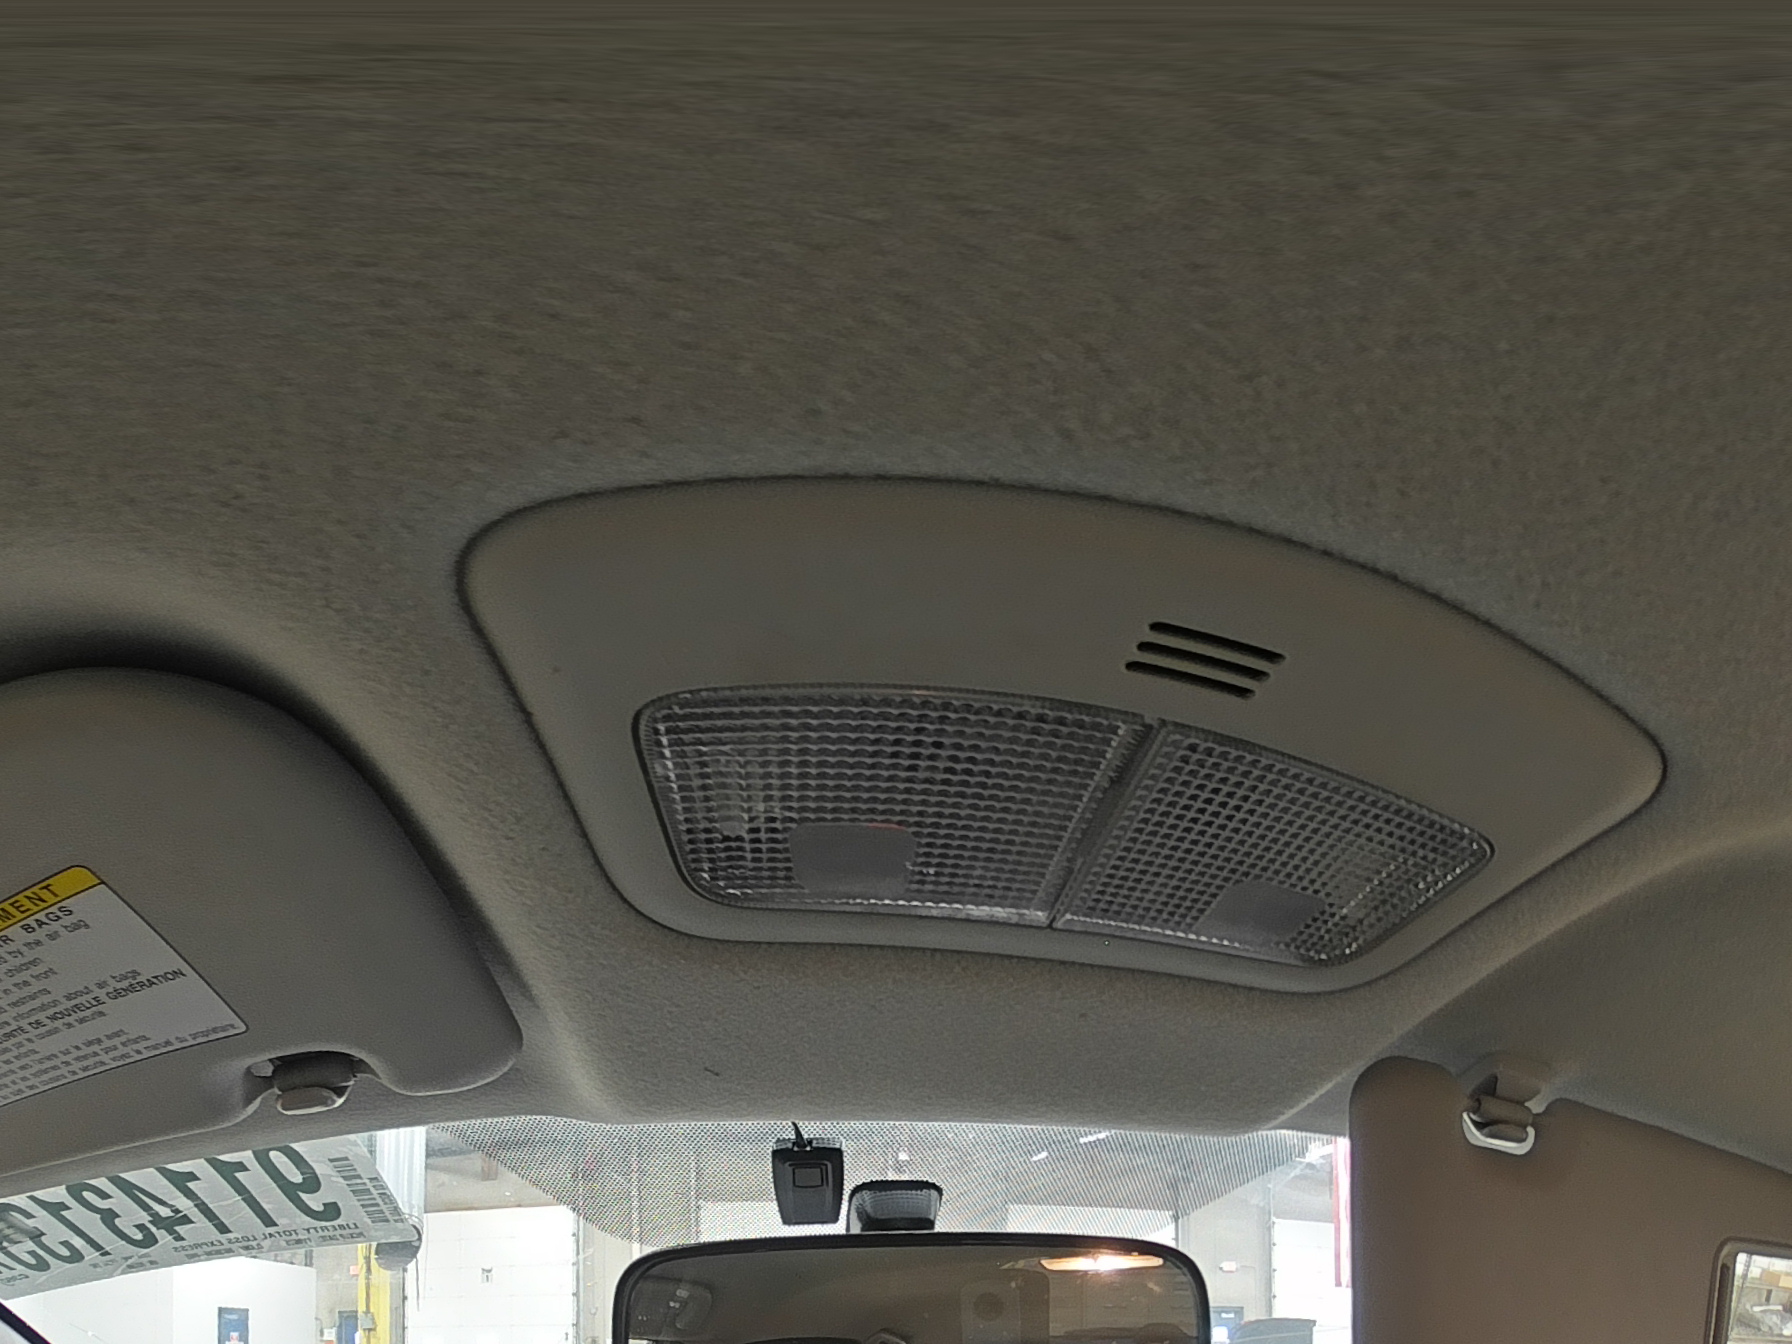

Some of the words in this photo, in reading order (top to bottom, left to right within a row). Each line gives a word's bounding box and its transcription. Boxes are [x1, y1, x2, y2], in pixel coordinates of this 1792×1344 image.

[21, 904, 75, 934] BAGS
[62, 916, 91, 936] bag
[46, 995, 106, 1022] NOUVELLE
[103, 967, 187, 1000] GÉNÉRATION
